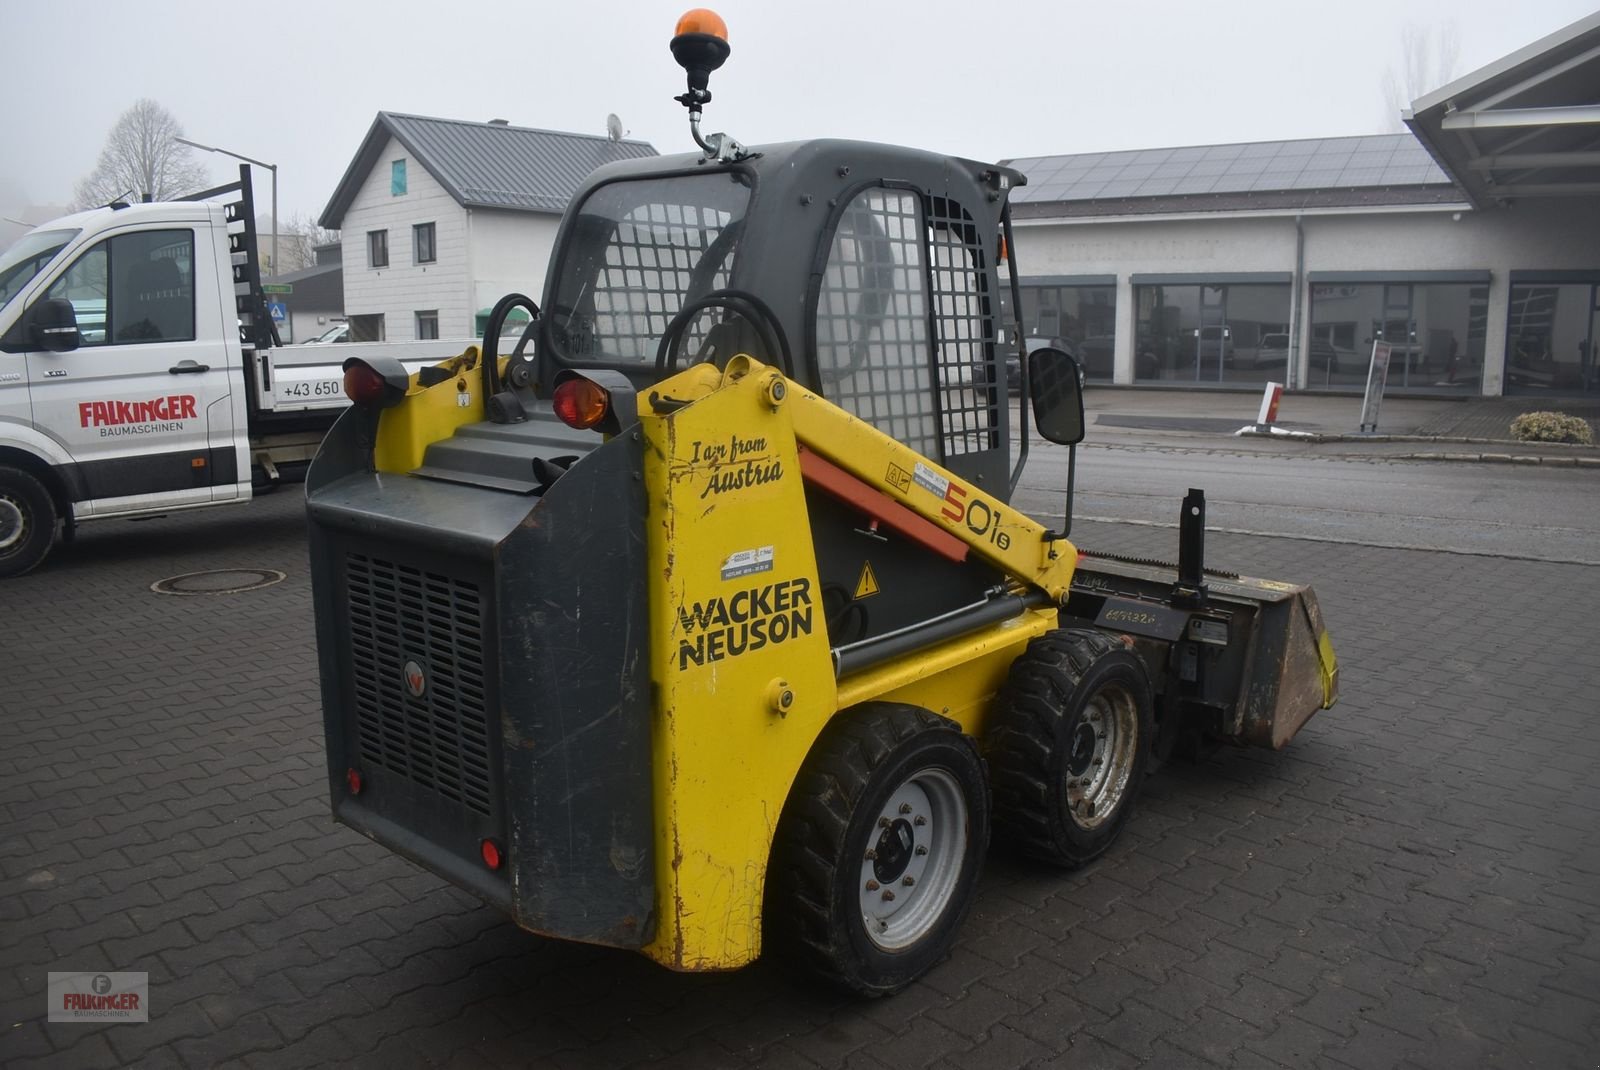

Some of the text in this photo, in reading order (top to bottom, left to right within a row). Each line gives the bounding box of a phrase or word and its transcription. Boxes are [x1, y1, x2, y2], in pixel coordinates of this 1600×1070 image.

[284, 381, 339, 396] +43 650
[79, 395, 198, 428] FALKINGER
[100, 422, 184, 437] BAUMASCHINEN
[691, 435, 768, 464] I am from
[701, 460, 784, 499] Austria
[677, 577, 812, 633] WACKER
[679, 606, 812, 672] NEUSON
